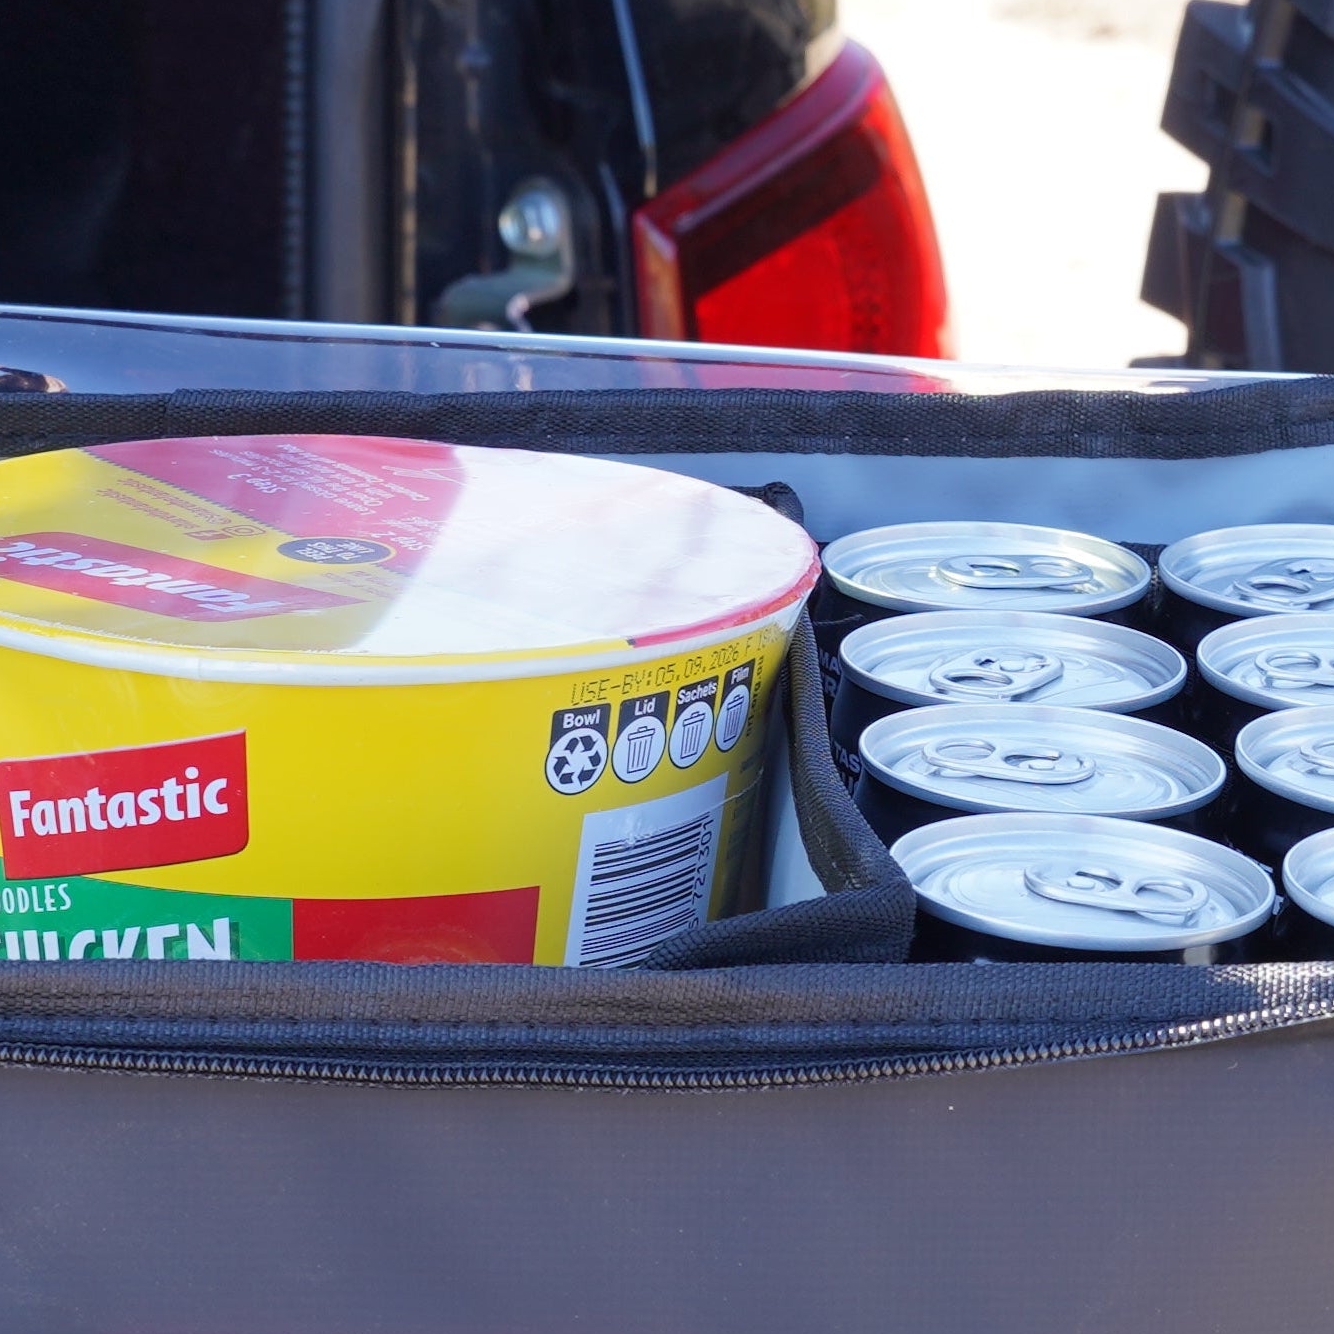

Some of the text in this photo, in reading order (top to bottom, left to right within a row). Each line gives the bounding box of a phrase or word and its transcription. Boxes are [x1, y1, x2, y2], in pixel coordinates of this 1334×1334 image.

[245, 479, 288, 492] Step
[389, 537, 433, 549] Step
[296, 548, 331, 558] PEEL
[336, 551, 361, 559] TO
[730, 667, 749, 685] Film
[677, 682, 717, 706] Sachets
[634, 698, 656, 716] Lid
[563, 710, 600, 729] Bowl
[8, 766, 229, 838] Fantastic
